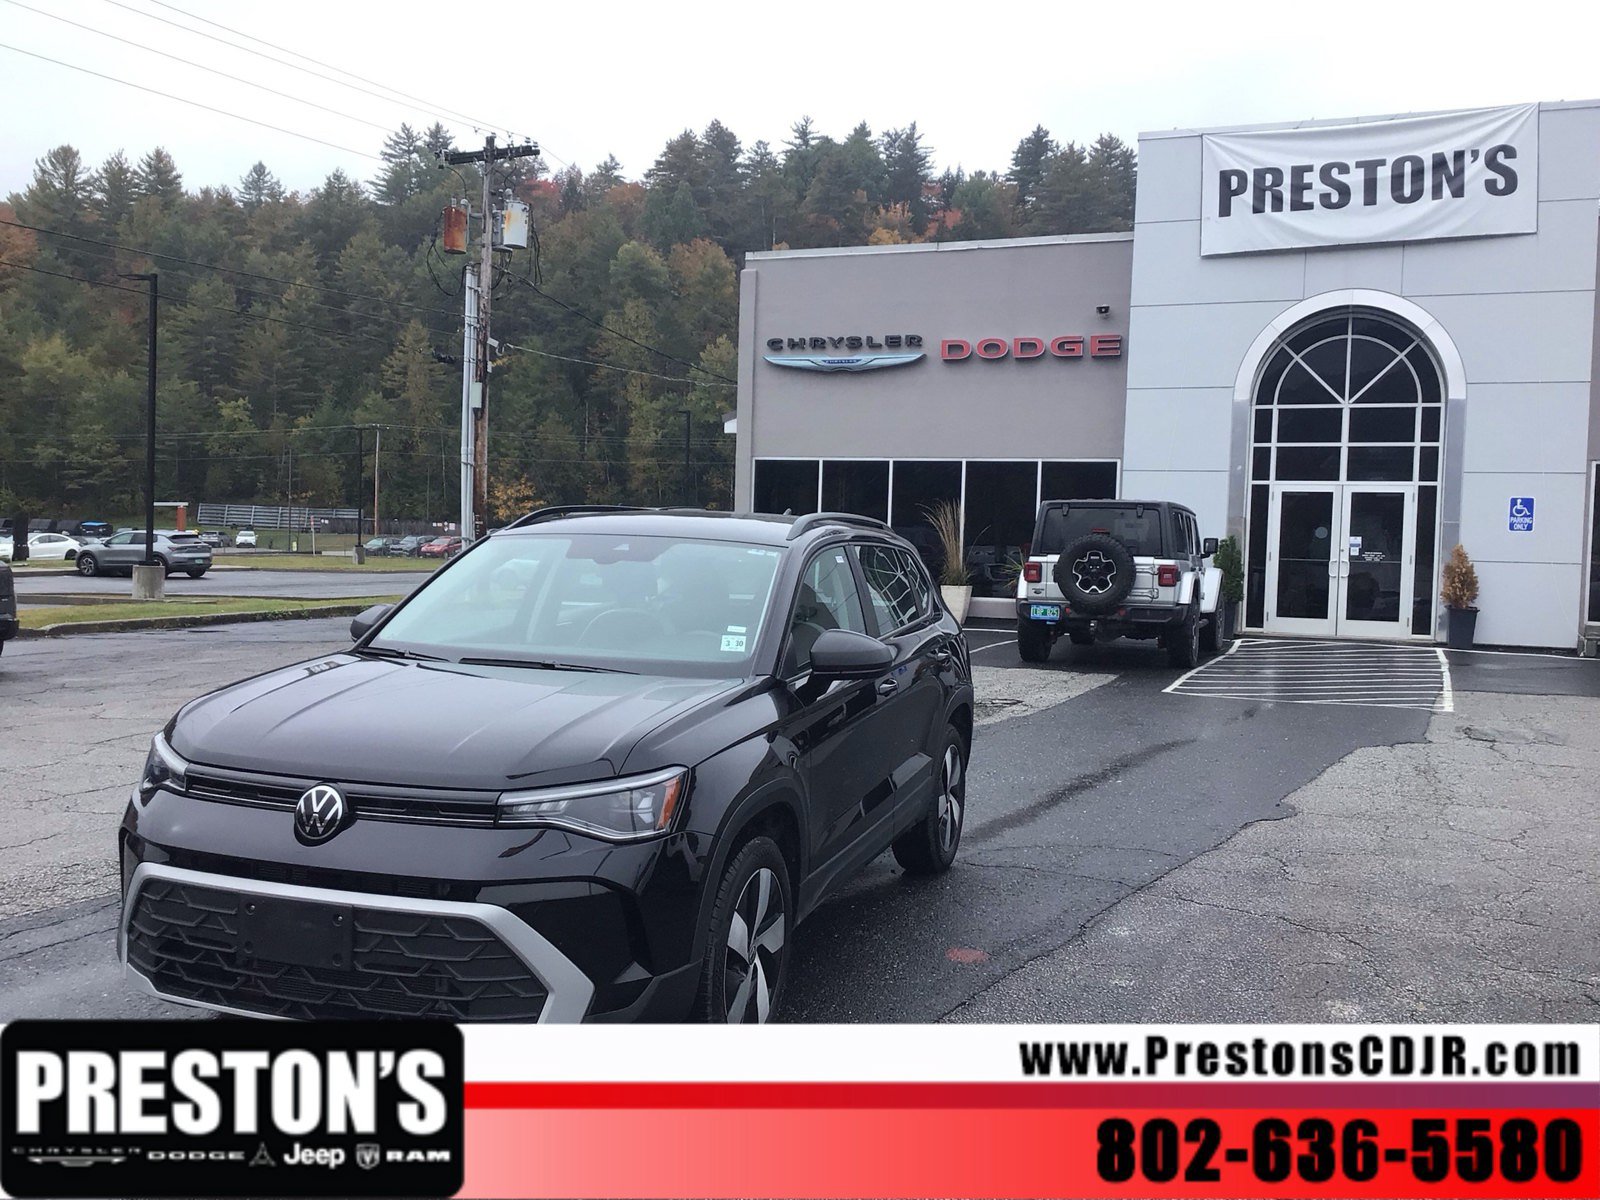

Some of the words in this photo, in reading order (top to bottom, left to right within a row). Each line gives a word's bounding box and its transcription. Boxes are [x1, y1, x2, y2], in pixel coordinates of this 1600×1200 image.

[1218, 144, 1519, 218] PRESTON'S
[766, 334, 923, 351] CHRYSLER
[940, 334, 1123, 361] DODGE
[1510, 516, 1533, 524] PARKING
